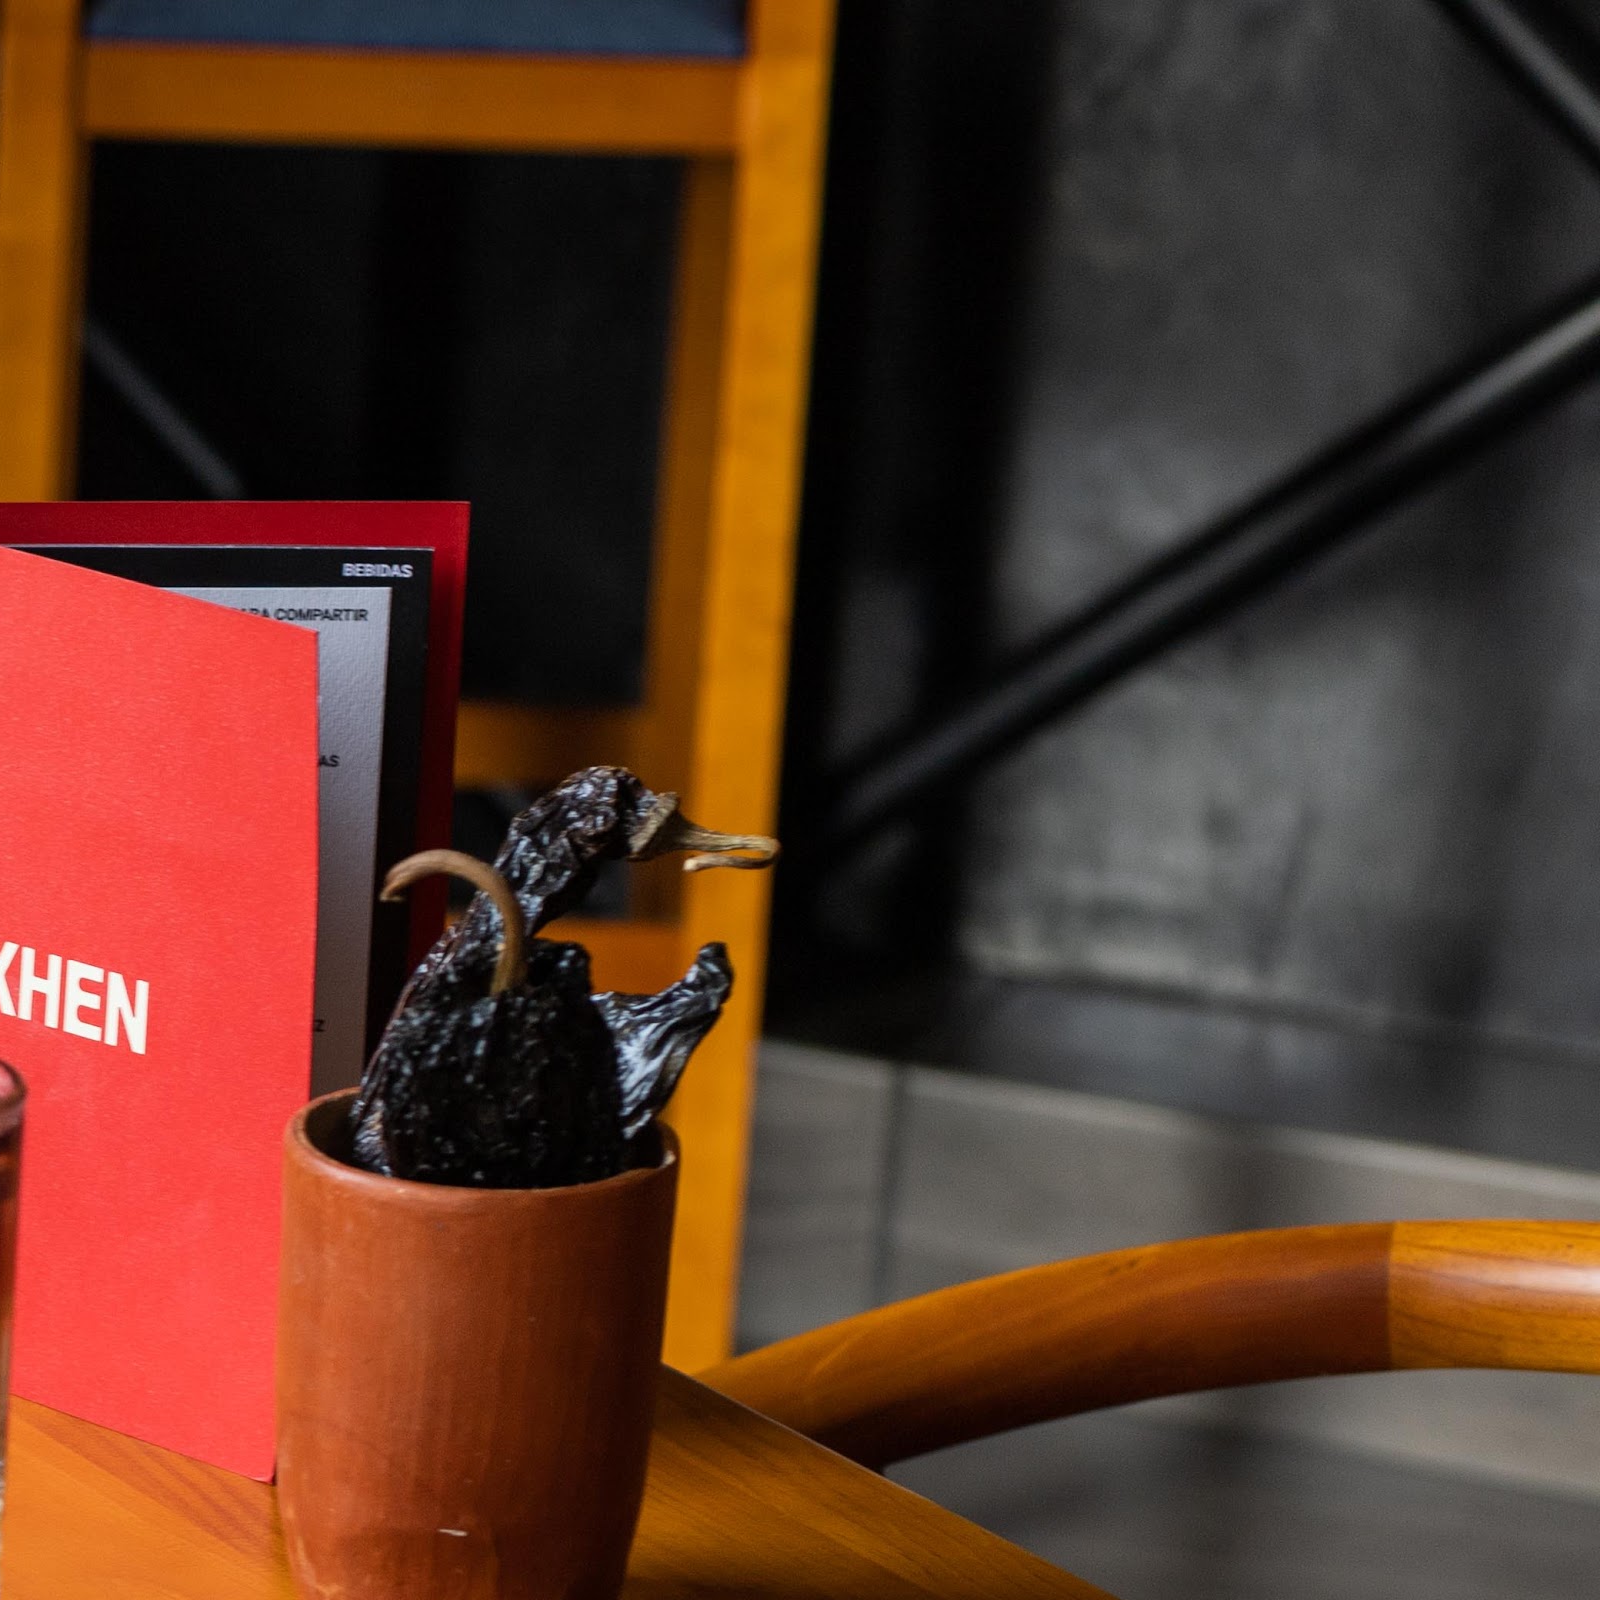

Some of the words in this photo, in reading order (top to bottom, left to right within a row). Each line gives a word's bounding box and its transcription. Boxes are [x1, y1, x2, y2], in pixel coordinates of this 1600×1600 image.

[342, 563, 413, 578] BEBIDAS
[231, 607, 270, 619] RA
[274, 608, 368, 622] COMPARTIR
